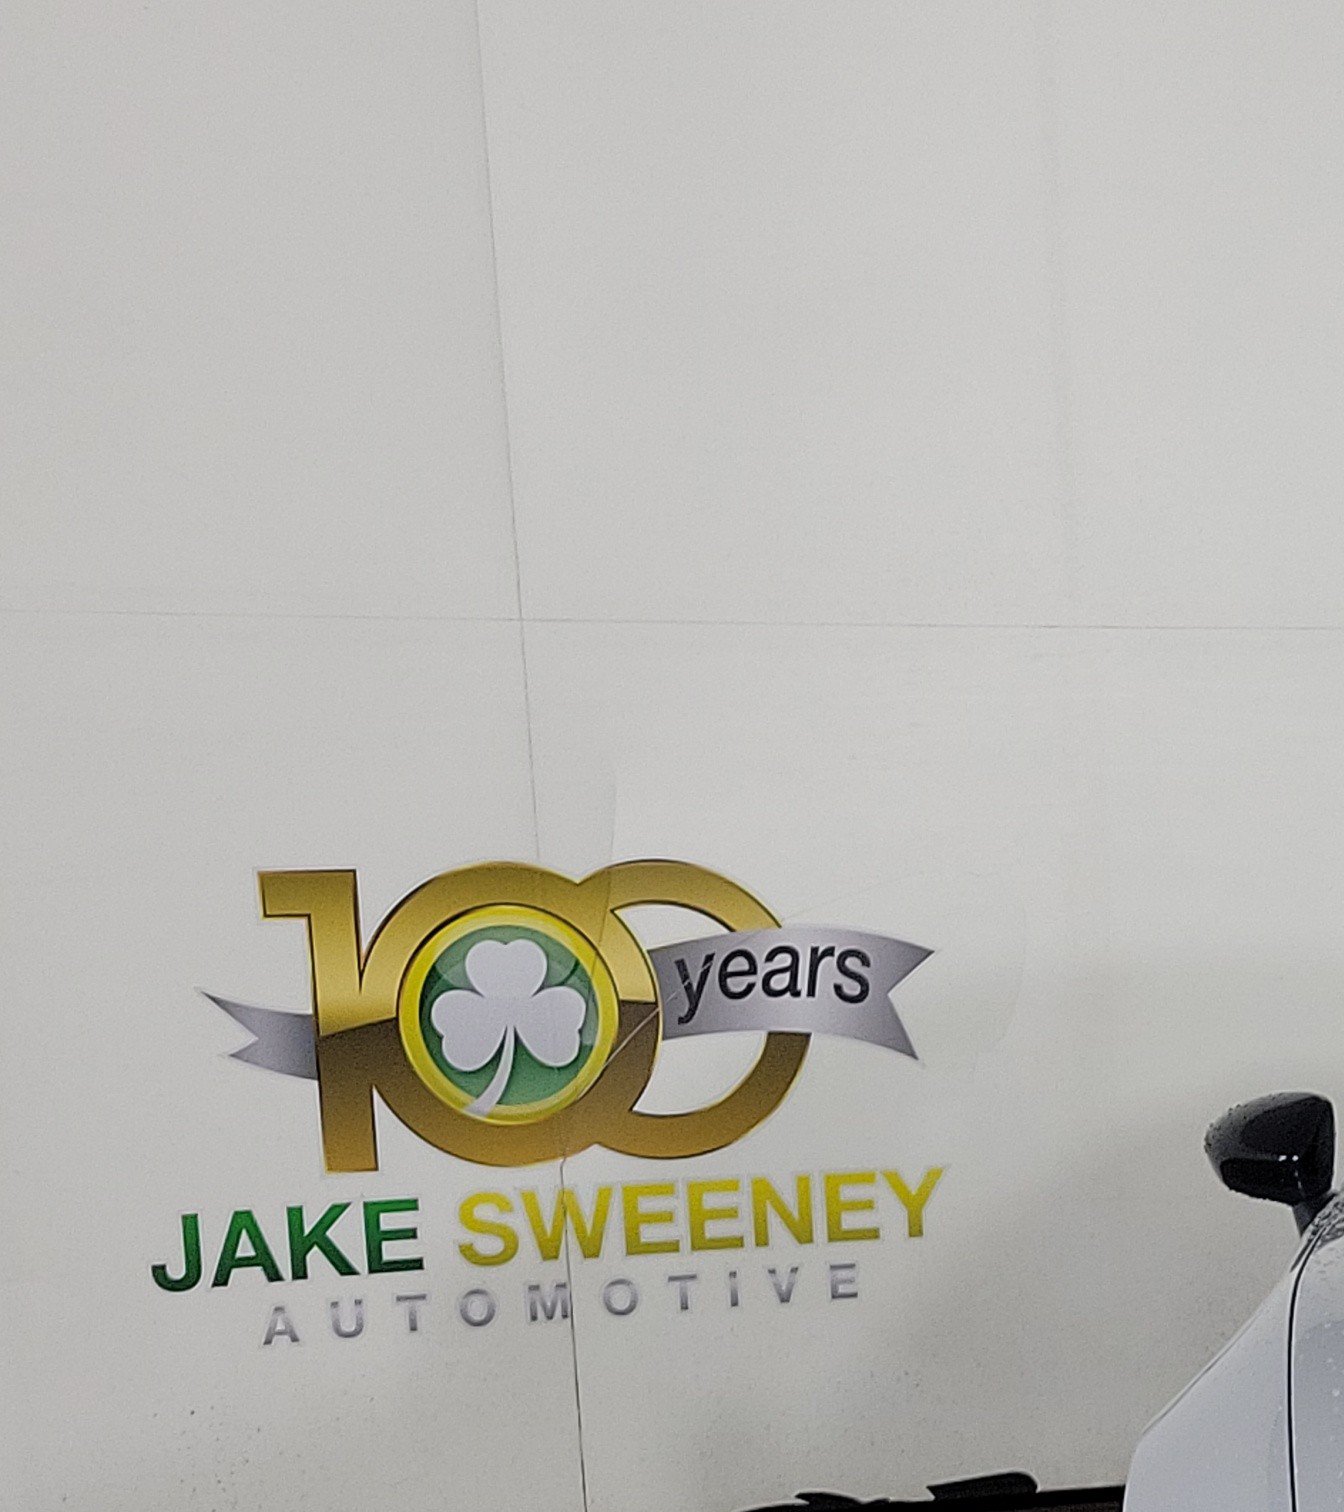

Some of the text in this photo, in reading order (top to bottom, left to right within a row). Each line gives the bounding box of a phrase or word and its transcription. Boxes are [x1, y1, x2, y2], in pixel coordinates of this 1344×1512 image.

[256, 858, 873, 1173] 100 years
[151, 1167, 945, 1292] JAKE SWEENEY
[262, 1262, 861, 1347] AUTOMOTIVE
